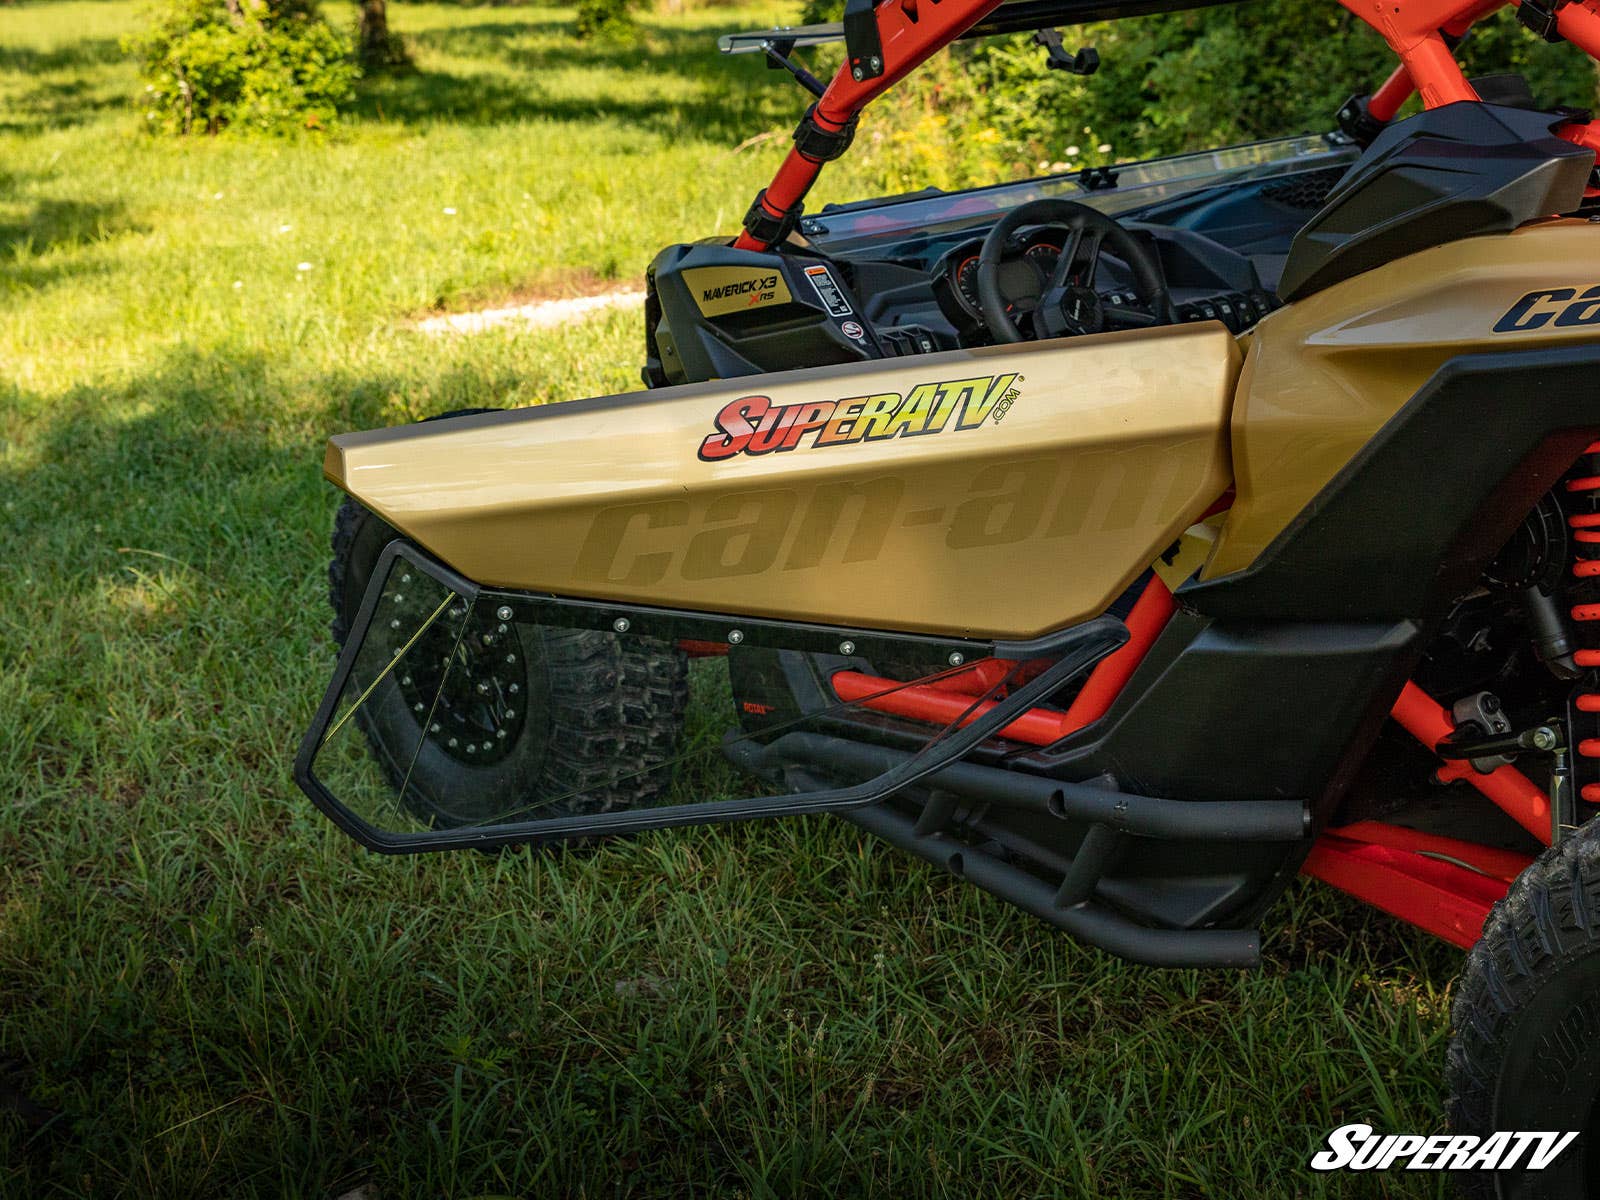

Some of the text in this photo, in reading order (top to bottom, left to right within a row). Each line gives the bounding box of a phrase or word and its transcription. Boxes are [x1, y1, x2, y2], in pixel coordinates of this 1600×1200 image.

[703, 276, 777, 302] MAVERICK X3
[575, 440, 1200, 587] can-am
